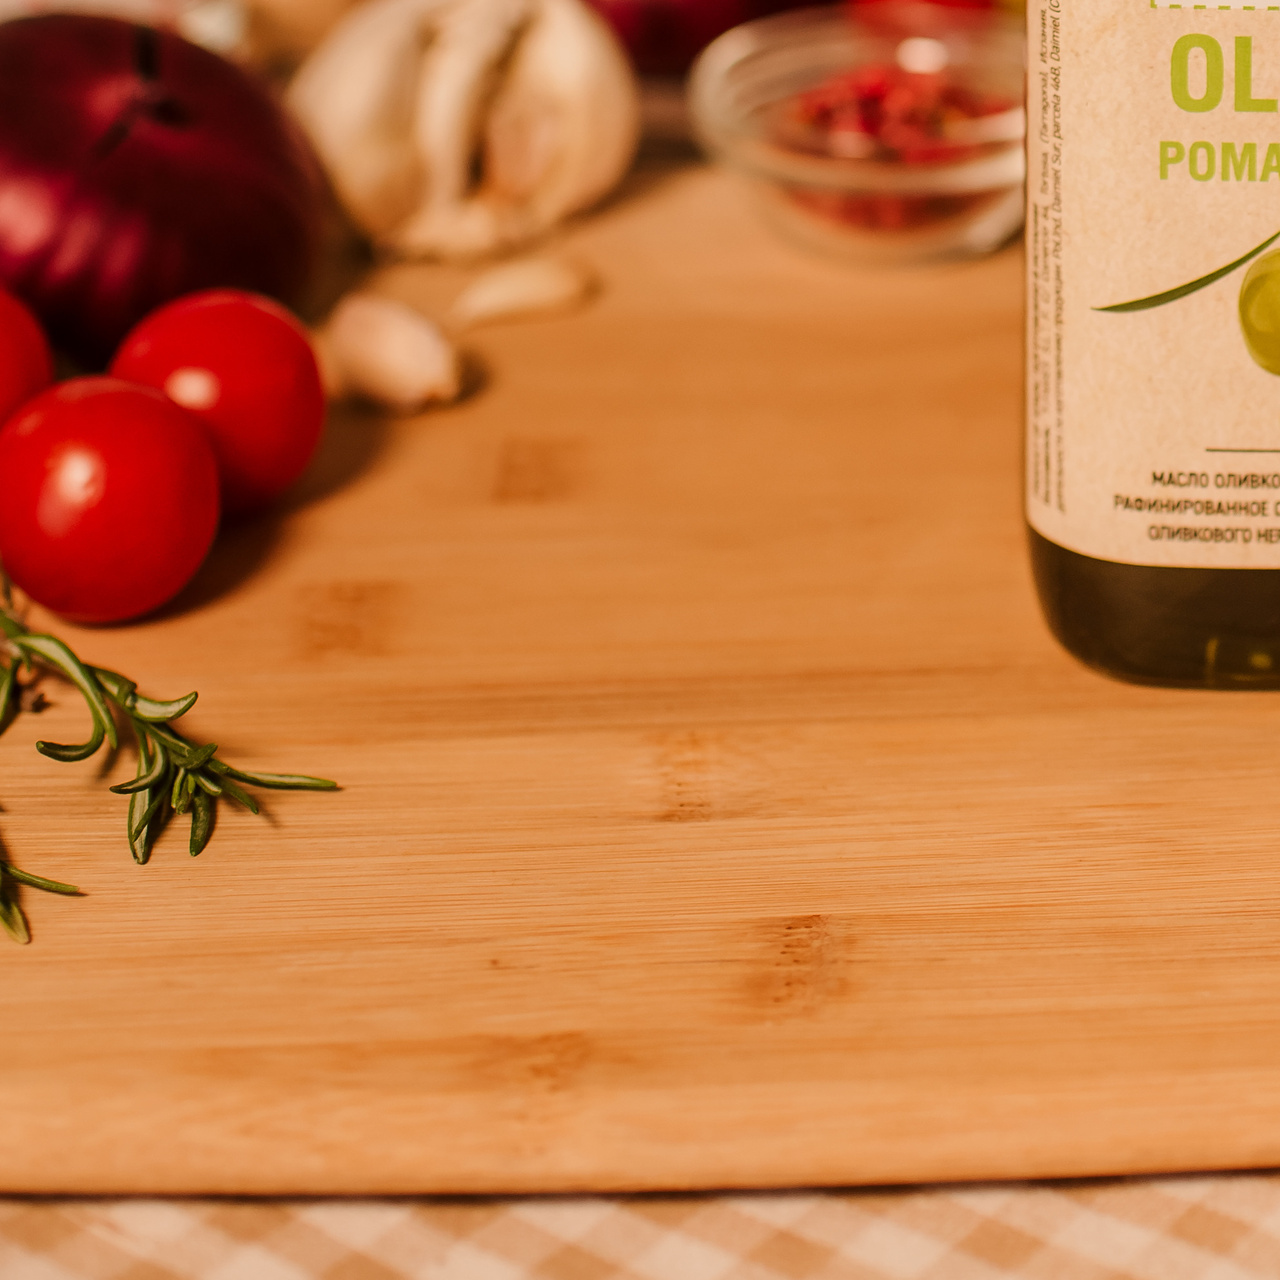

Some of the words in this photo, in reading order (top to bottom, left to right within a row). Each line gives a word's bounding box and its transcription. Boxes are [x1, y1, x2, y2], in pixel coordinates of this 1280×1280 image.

[1049, 16, 1061, 62] Daimiel
[1050, 94, 1064, 141] parcela
[1152, 471, 1209, 488] МАСЛО
[1114, 494, 1268, 516] РАФИНИРОВАННОЕ
[1148, 524, 1252, 543] ОЛИВКОВОГО
